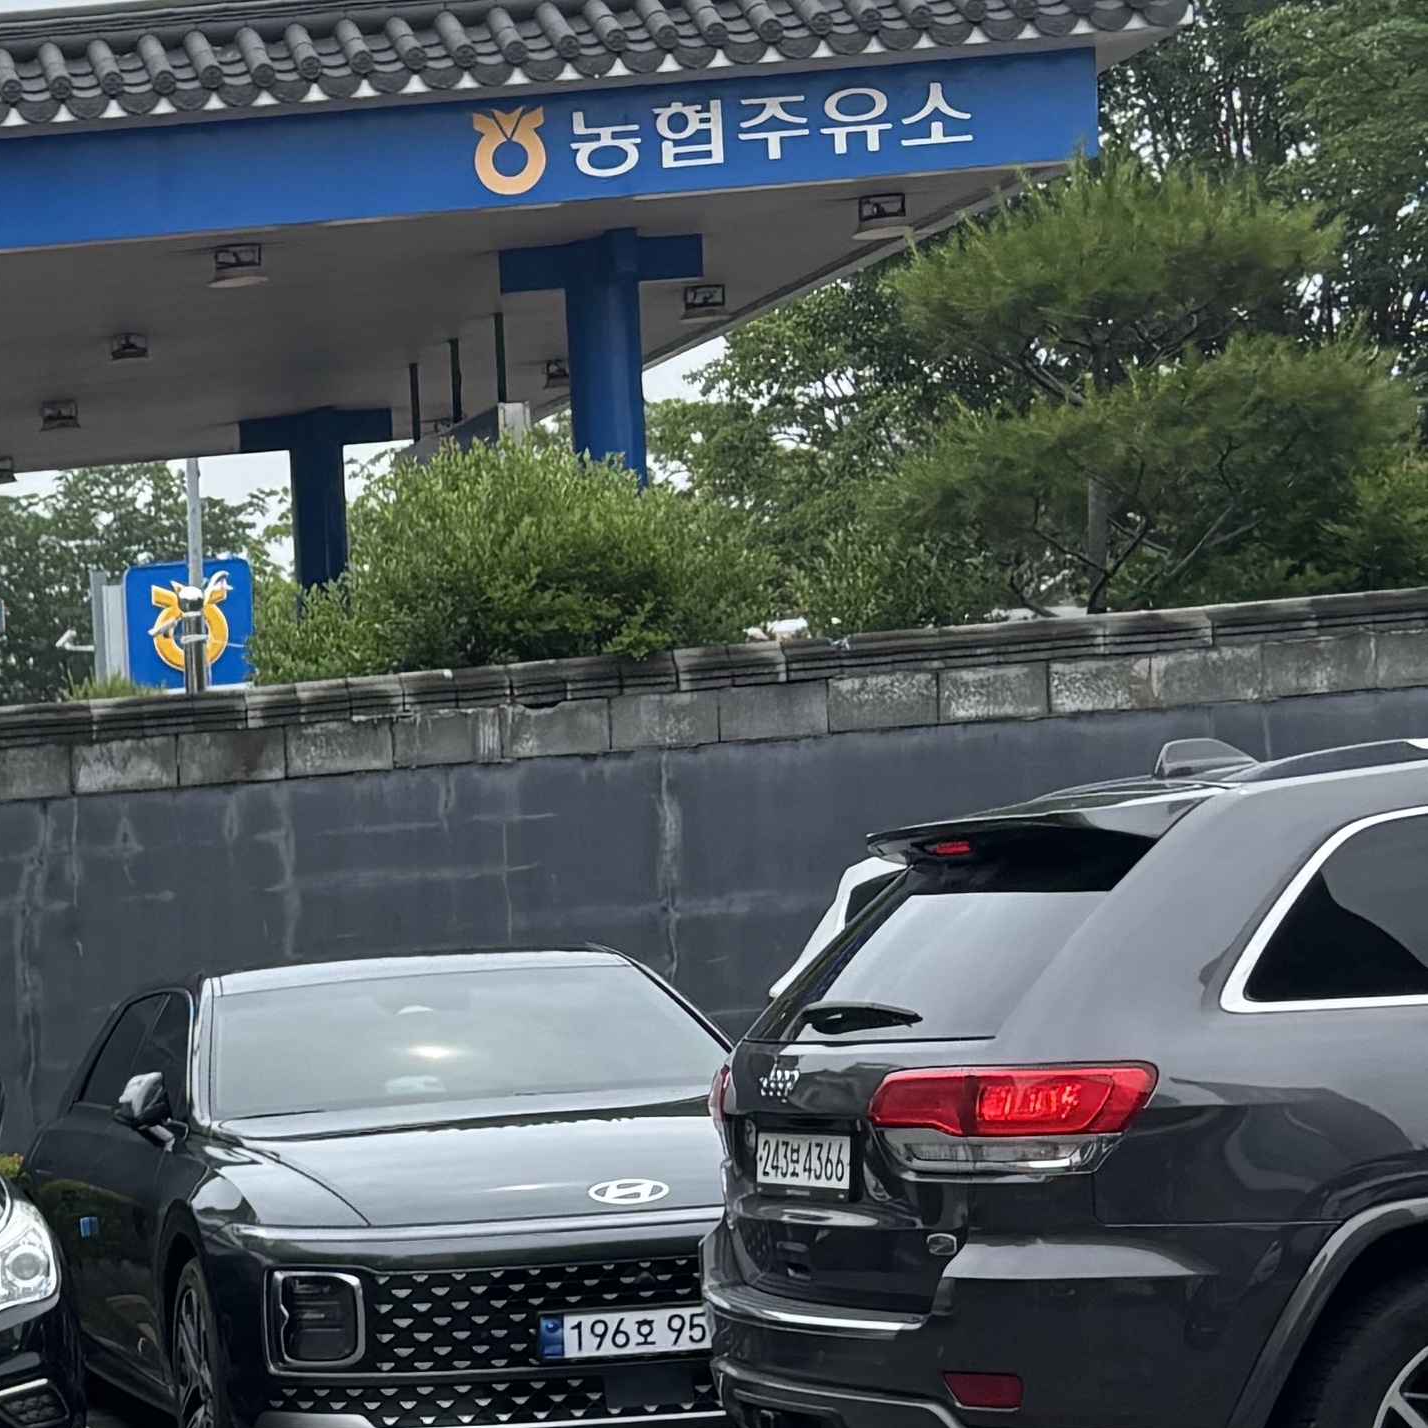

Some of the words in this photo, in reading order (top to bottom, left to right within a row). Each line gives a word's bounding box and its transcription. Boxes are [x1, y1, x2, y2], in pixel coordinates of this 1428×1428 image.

[570, 82, 973, 178] 농협주유소
[762, 1139, 800, 1178] 243보
[803, 1141, 845, 1182] 4366
[570, 1317, 656, 1352] 196호
[667, 1313, 707, 1346] 95
